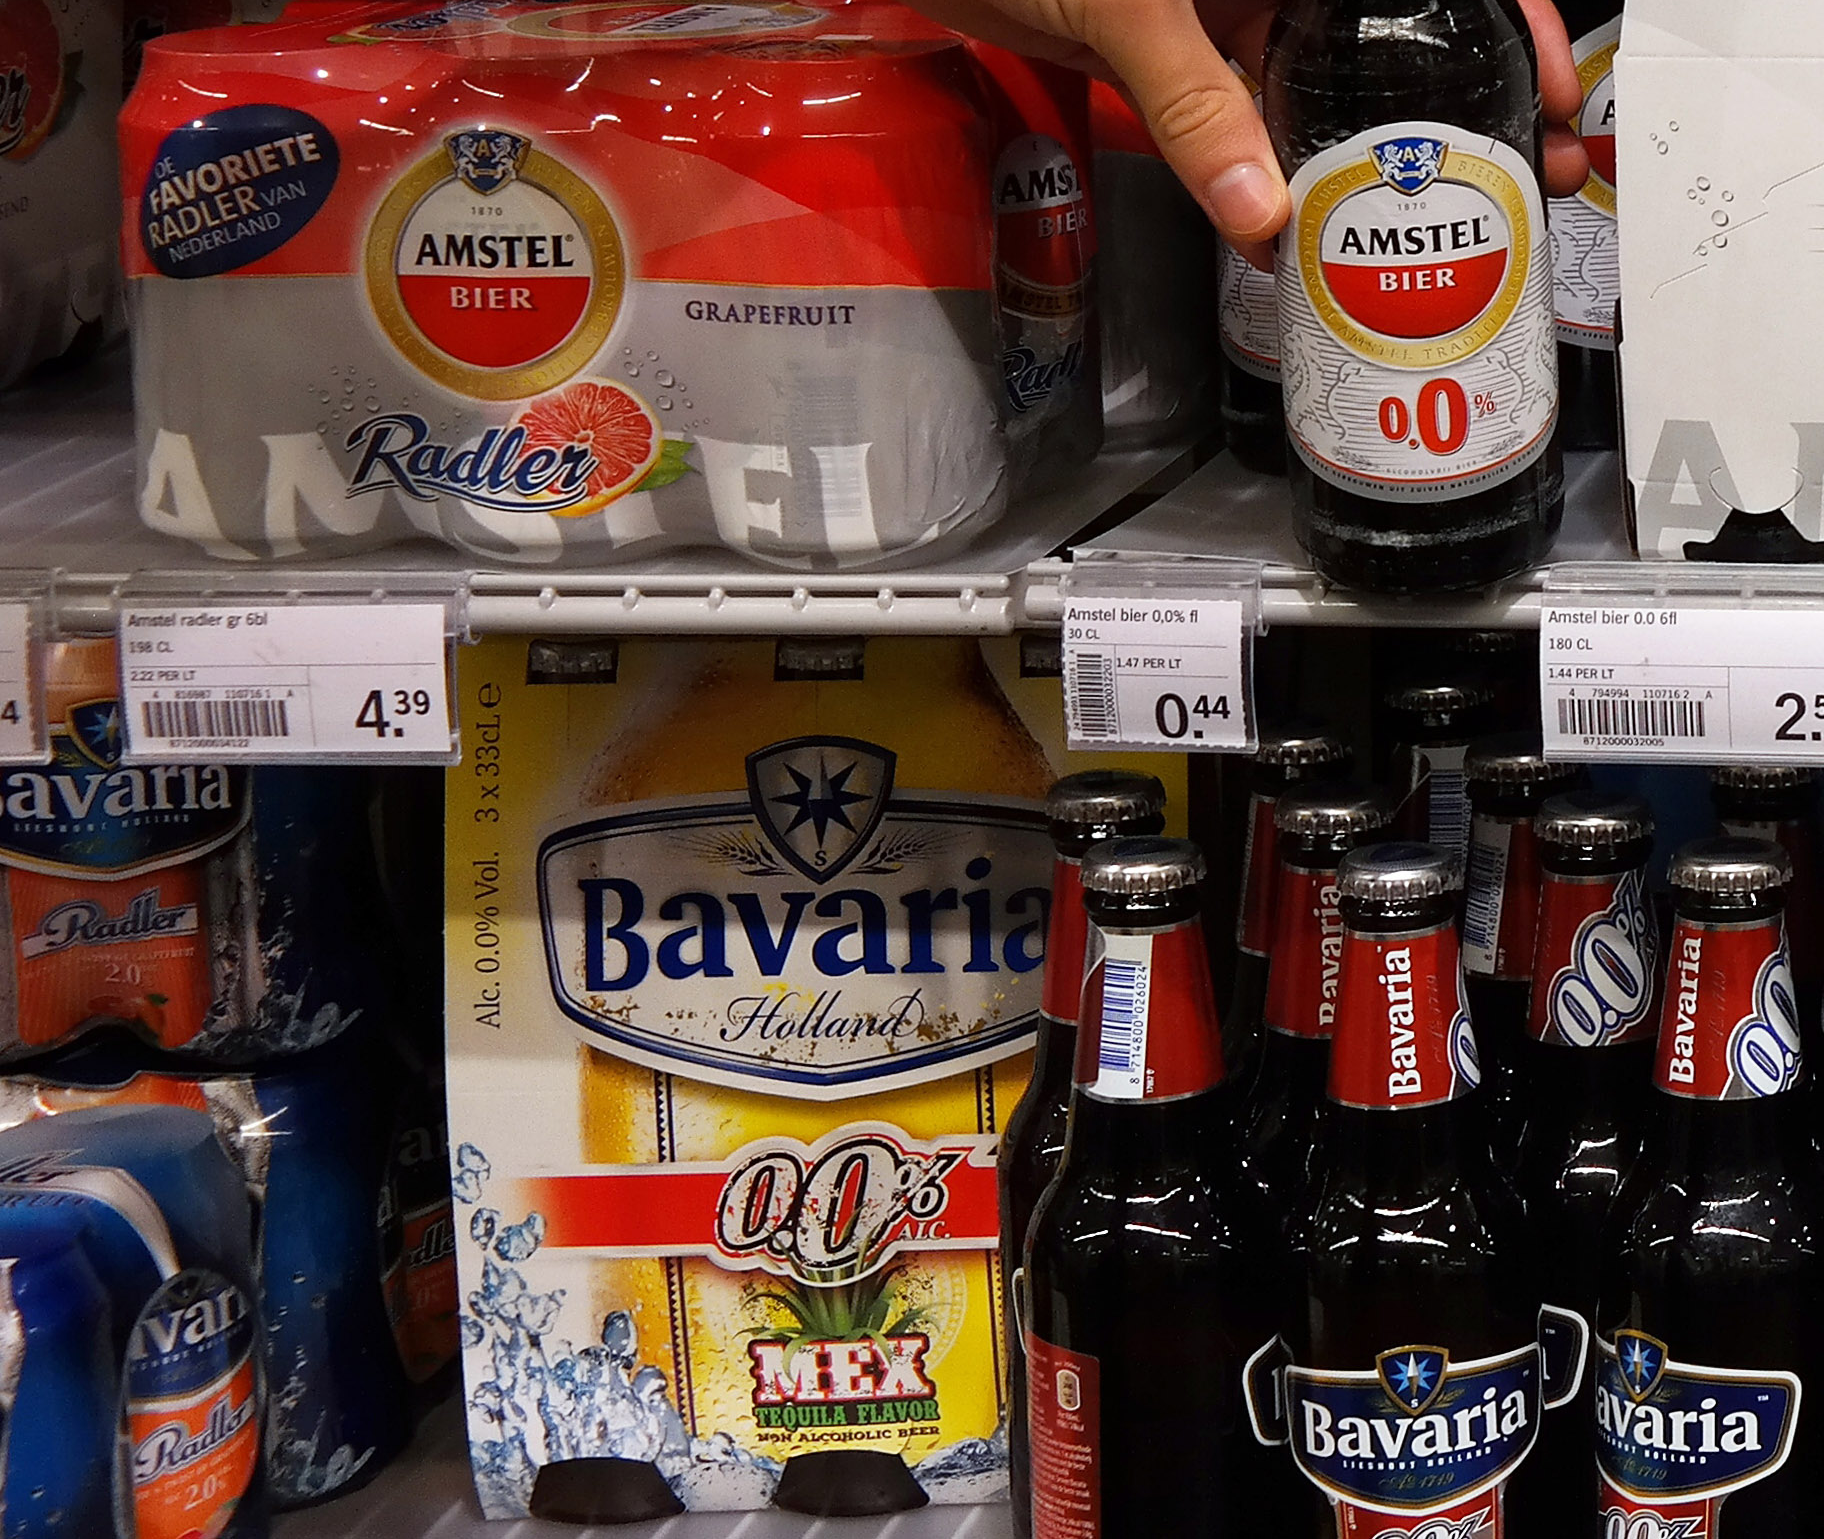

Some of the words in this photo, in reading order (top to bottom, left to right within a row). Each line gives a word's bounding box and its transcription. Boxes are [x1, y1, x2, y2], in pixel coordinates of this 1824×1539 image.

[149, 130, 322, 216] FAVORIETE
[154, 155, 176, 180] DE
[147, 183, 258, 251] RADLER
[259, 180, 308, 209] VAN
[168, 210, 282, 265] NEDERLAND
[415, 232, 573, 271] AMSTEL
[684, 300, 856, 327] GRAPEFRUIT
[346, 411, 600, 511] Radler
[128, 613, 176, 628] Amstel
[180, 612, 222, 627] radler
[228, 616, 242, 630] gr
[246, 612, 267, 627] 6bl
[1068, 608, 1116, 622] Amstel
[1120, 609, 1148, 622] bier
[1152, 609, 1185, 624] 0,0%
[1549, 610, 1597, 625] Amstel
[1601, 611, 1630, 625] bier
[1633, 612, 1655, 625] 0.0
[354, 689, 431, 738] 4.39
[1155, 692, 1231, 739] 0.44
[578, 857, 1051, 992] Bavaria
[719, 987, 925, 1043] Holland
[718, 1133, 950, 1260] 0.0%
[899, 1220, 951, 1240] ALC.
[751, 1336, 935, 1402] MEX
[756, 1404, 847, 1431] TEQUILA
[857, 1400, 940, 1425] FLAVOR
[757, 1431, 793, 1443] NON
[799, 1428, 891, 1443] ALCOHOLIC
[898, 1426, 940, 1438] BEER
[1302, 1385, 1528, 1458] Bavaria
